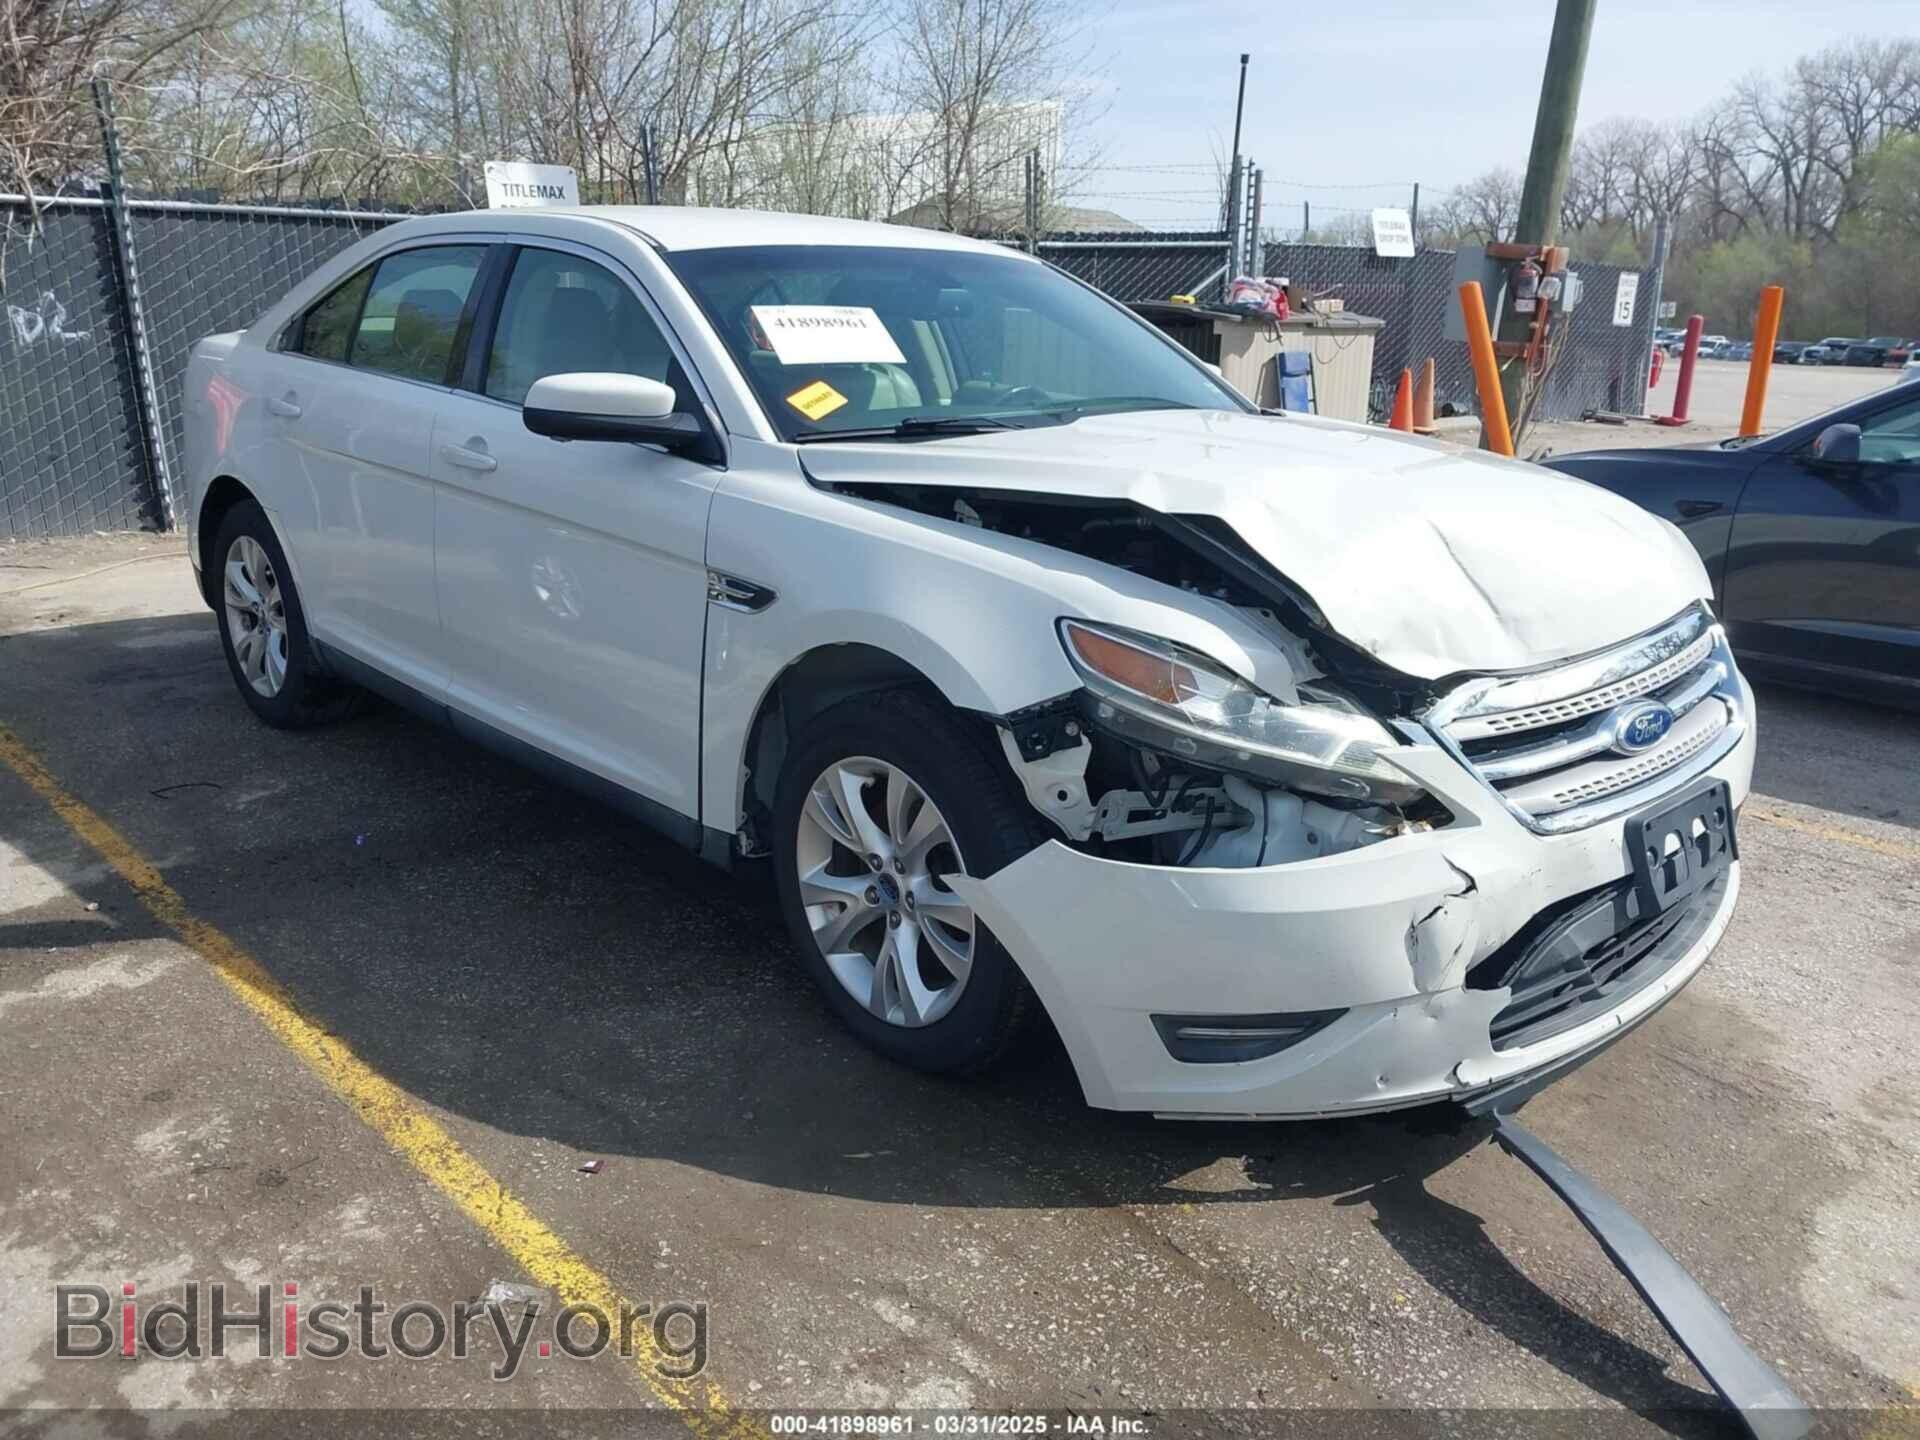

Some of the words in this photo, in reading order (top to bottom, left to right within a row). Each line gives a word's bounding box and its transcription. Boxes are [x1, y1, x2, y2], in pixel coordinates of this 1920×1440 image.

[501, 183, 566, 200] TITLEMAX
[1618, 301, 1631, 320] 15
[774, 316, 869, 329] 41898961
[1635, 713, 1664, 742] Ford
